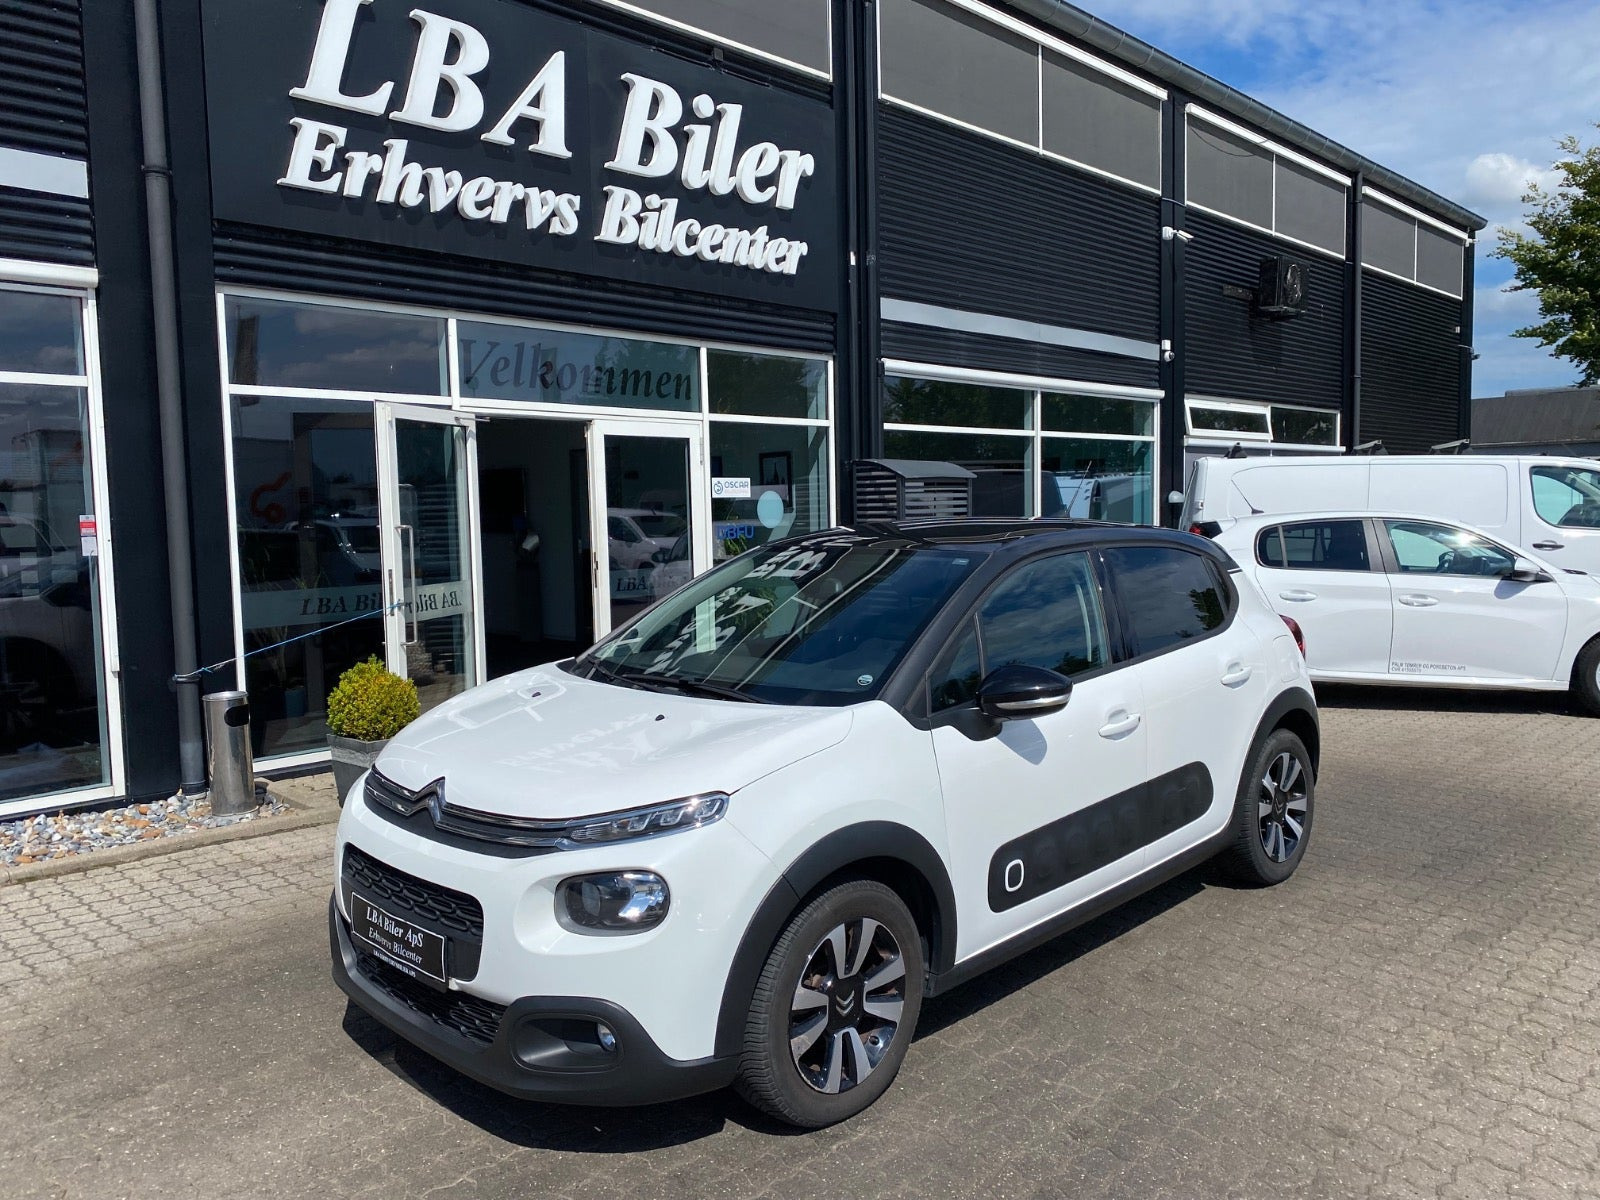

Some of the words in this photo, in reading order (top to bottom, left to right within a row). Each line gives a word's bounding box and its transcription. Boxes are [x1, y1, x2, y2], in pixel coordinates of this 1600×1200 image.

[289, 0, 573, 158] LBA
[604, 72, 815, 210] Biler
[276, 117, 581, 236] Erhvervs
[594, 184, 809, 275] Bilcenter
[460, 338, 692, 400] Velkommen
[724, 480, 749, 489] OSCAR
[616, 575, 648, 592] LBA
[299, 595, 348, 616] LBA
[352, 593, 383, 612] Bil
[366, 906, 383, 927] LBA
[384, 916, 404, 938] Biler
[405, 928, 424, 948] ApS
[393, 941, 422, 965] Bilcenter
